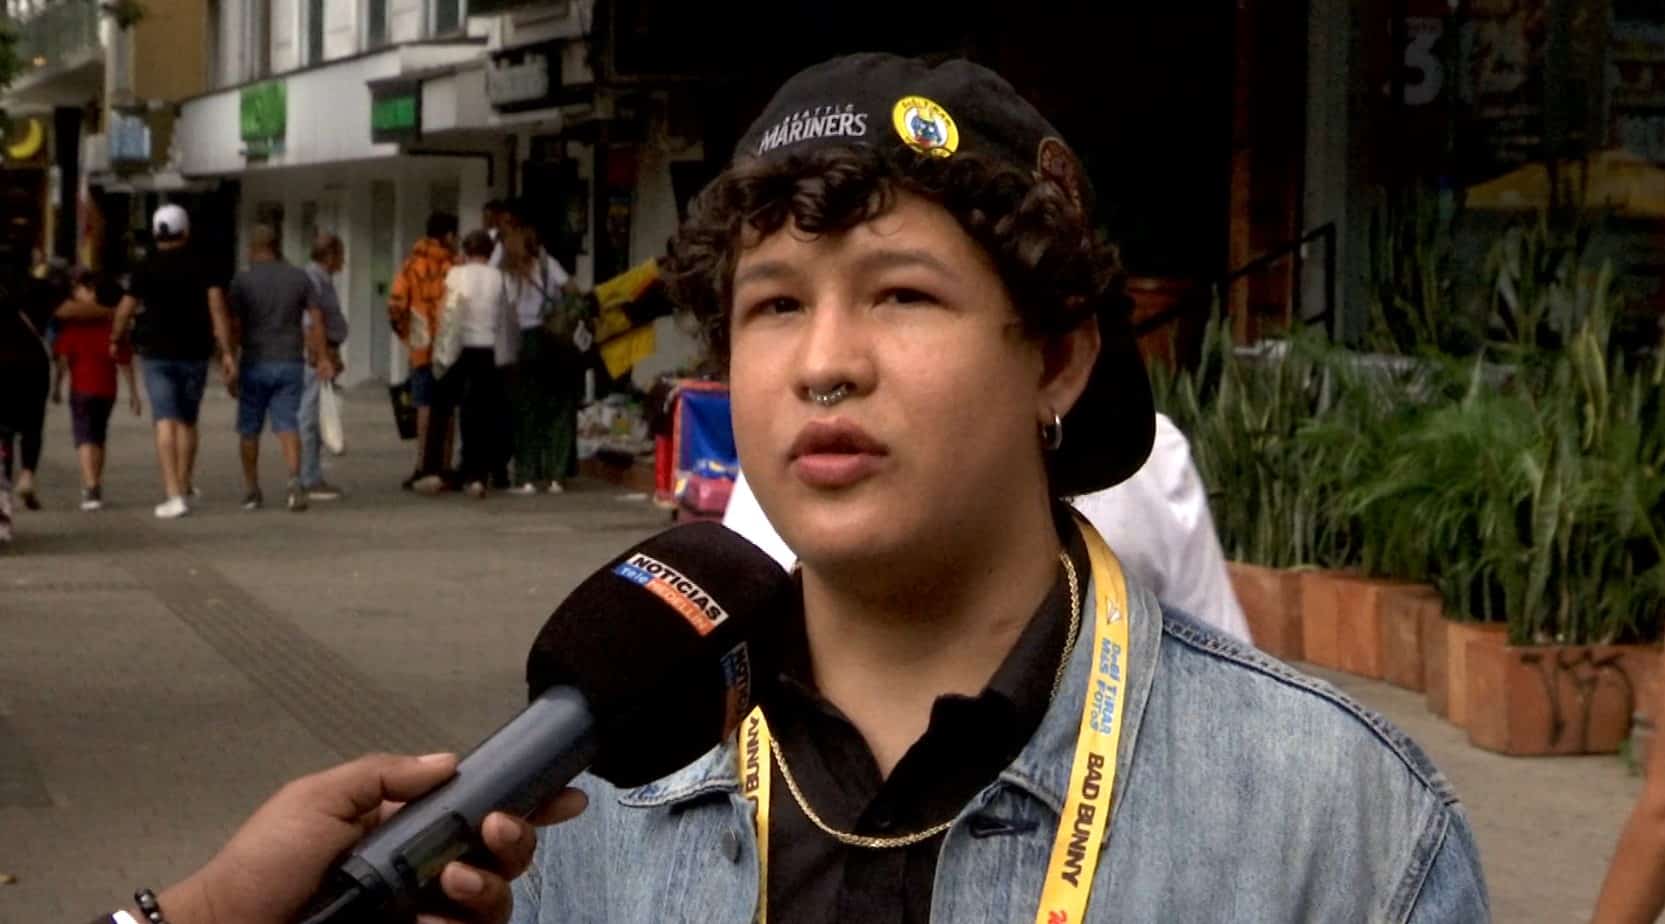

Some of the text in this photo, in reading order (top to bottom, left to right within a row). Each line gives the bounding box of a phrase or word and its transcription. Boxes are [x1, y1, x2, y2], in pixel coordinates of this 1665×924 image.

[758, 112, 869, 156] MARINERS
[631, 556, 722, 621] NOTICIAS
[746, 716, 760, 793] BUNNY
[1061, 752, 1105, 889] BAD BUNNY
